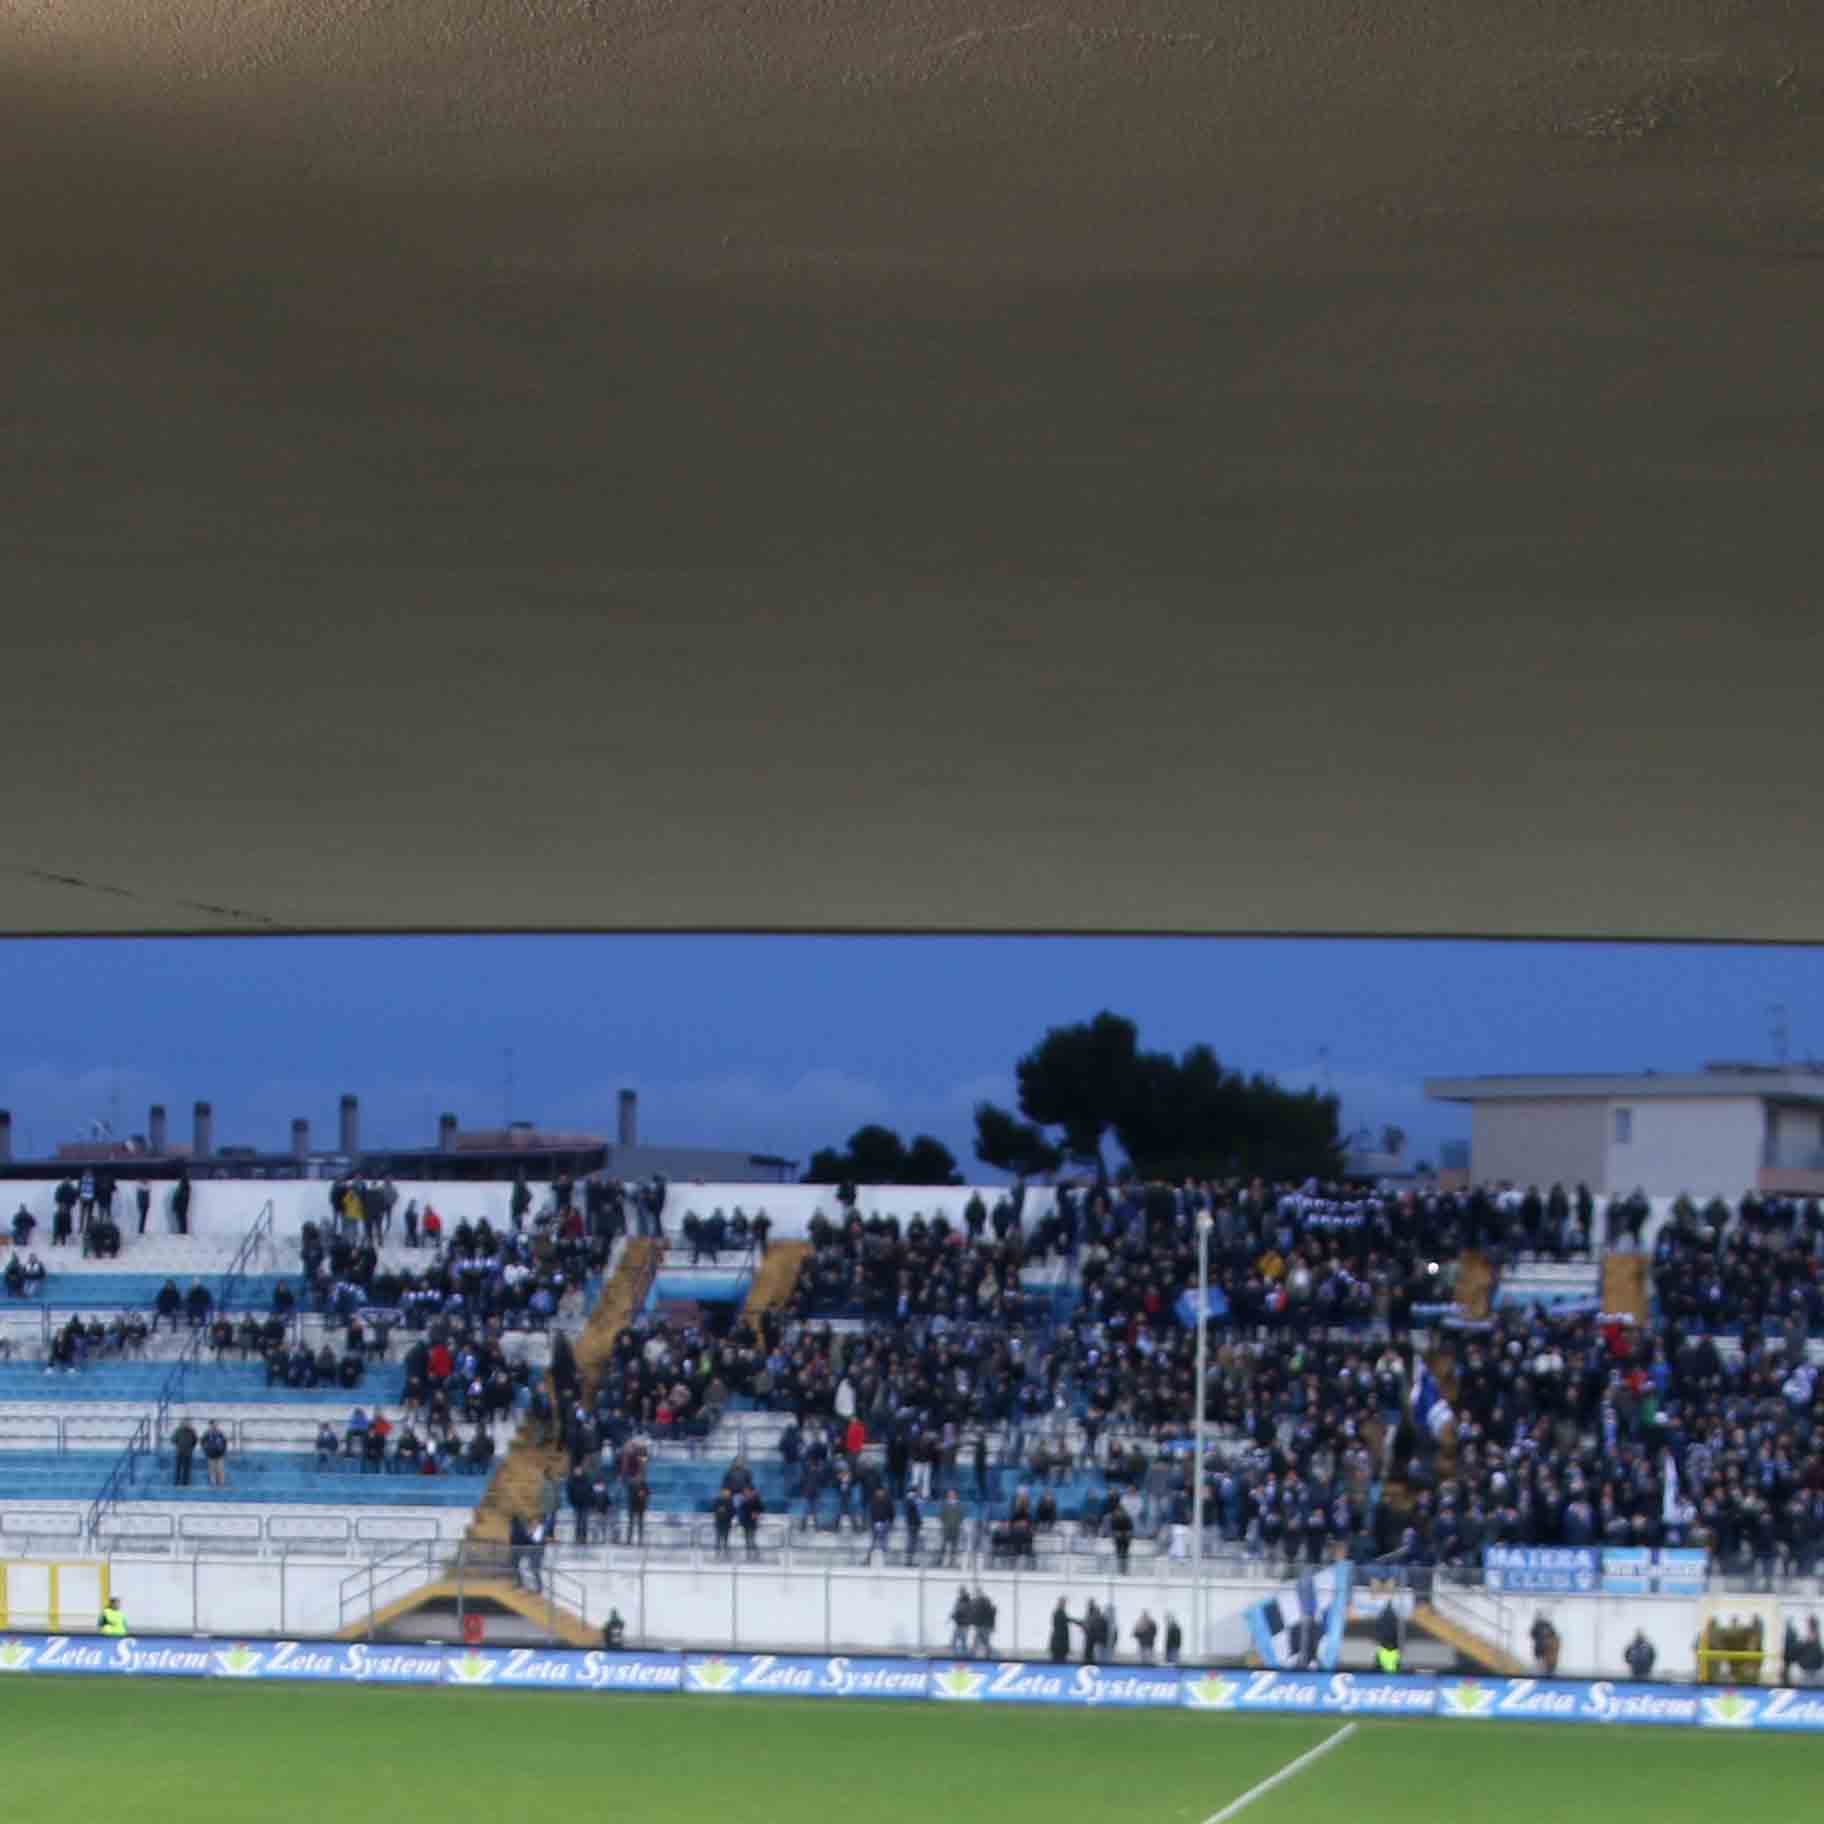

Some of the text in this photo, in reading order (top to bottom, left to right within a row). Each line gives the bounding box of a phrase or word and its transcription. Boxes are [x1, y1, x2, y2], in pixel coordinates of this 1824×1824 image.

[39, 1636, 209, 1671] Zeta System
[271, 1641, 437, 1680] Zeta System
[500, 1649, 678, 1686] Zeta System
[741, 1655, 929, 1694] Zeta System
[987, 1662, 1179, 1702] Zeta System
[1239, 1670, 1435, 1711] Zeta System
[1497, 1678, 1698, 1721] Zeta System
